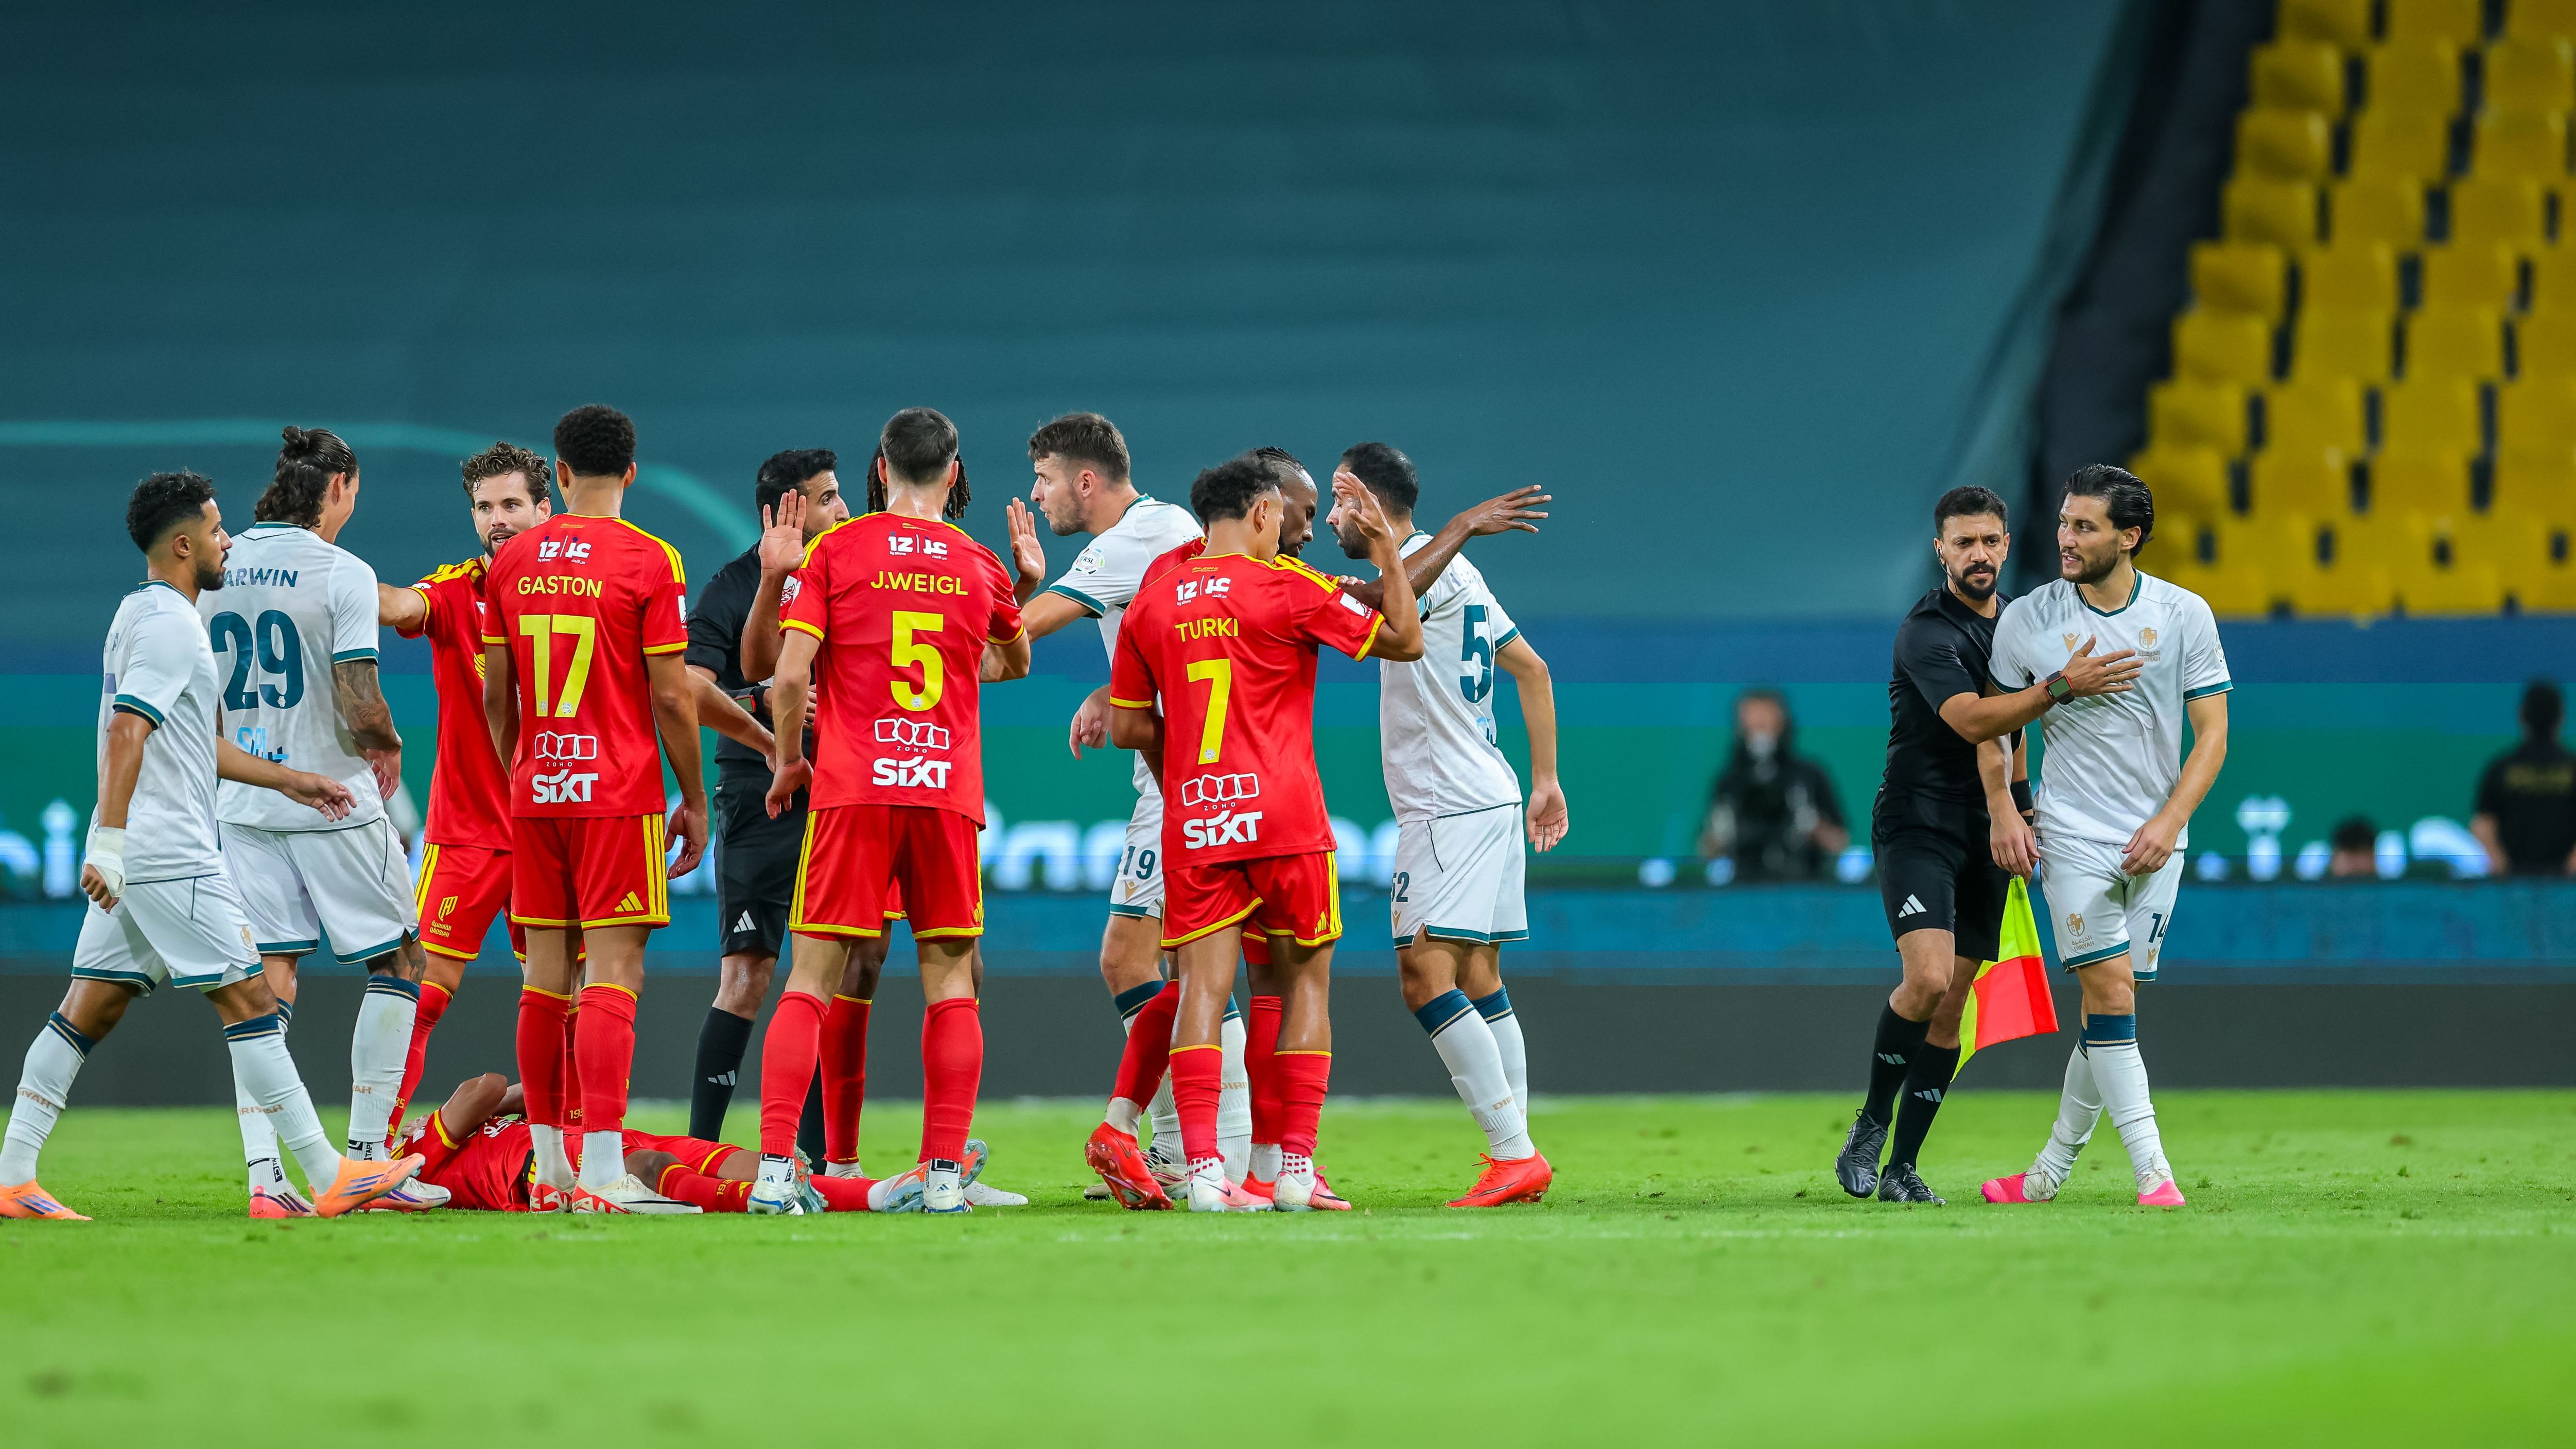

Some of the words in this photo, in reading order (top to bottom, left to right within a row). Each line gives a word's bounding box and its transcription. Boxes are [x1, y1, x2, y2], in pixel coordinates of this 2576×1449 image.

[223, 568, 298, 588] ARWIN
[518, 575, 602, 598] GASTON
[871, 571, 968, 595] J.WEIGL
[1175, 618, 1239, 642] TURKI
[210, 609, 304, 712] 29
[519, 614, 596, 718] 17
[890, 610, 944, 711] 5
[1460, 604, 1494, 703] 5
[1187, 658, 1232, 765] 7
[532, 769, 599, 804] SIXT
[873, 756, 951, 789] SIXT
[1204, 802, 1235, 811] ZOHO
[1183, 810, 1263, 849] SIXT
[1123, 846, 1156, 880] 19
[429, 927, 450, 938] QADSIAH
[2148, 912, 2169, 944] 14
[2074, 941, 2095, 951] DIRIYAH
[395, 1097, 406, 1109] 35
